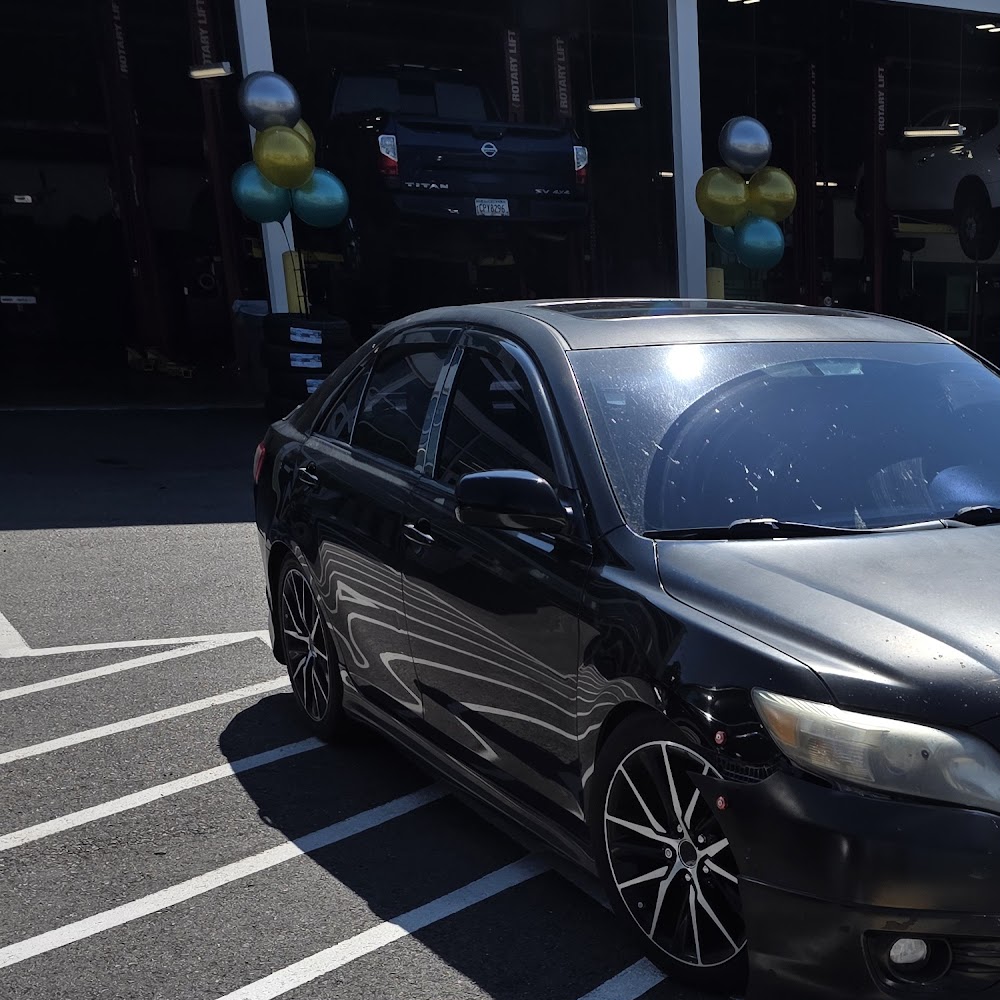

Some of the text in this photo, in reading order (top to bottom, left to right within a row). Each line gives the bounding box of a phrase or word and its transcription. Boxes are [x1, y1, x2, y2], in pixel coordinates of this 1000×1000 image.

[508, 30, 520, 102] ROTARY LIFT
[556, 38, 569, 109] ROTARY LIFT
[877, 67, 886, 131] ROTARY LIFT
[404, 181, 449, 191] TITAN
